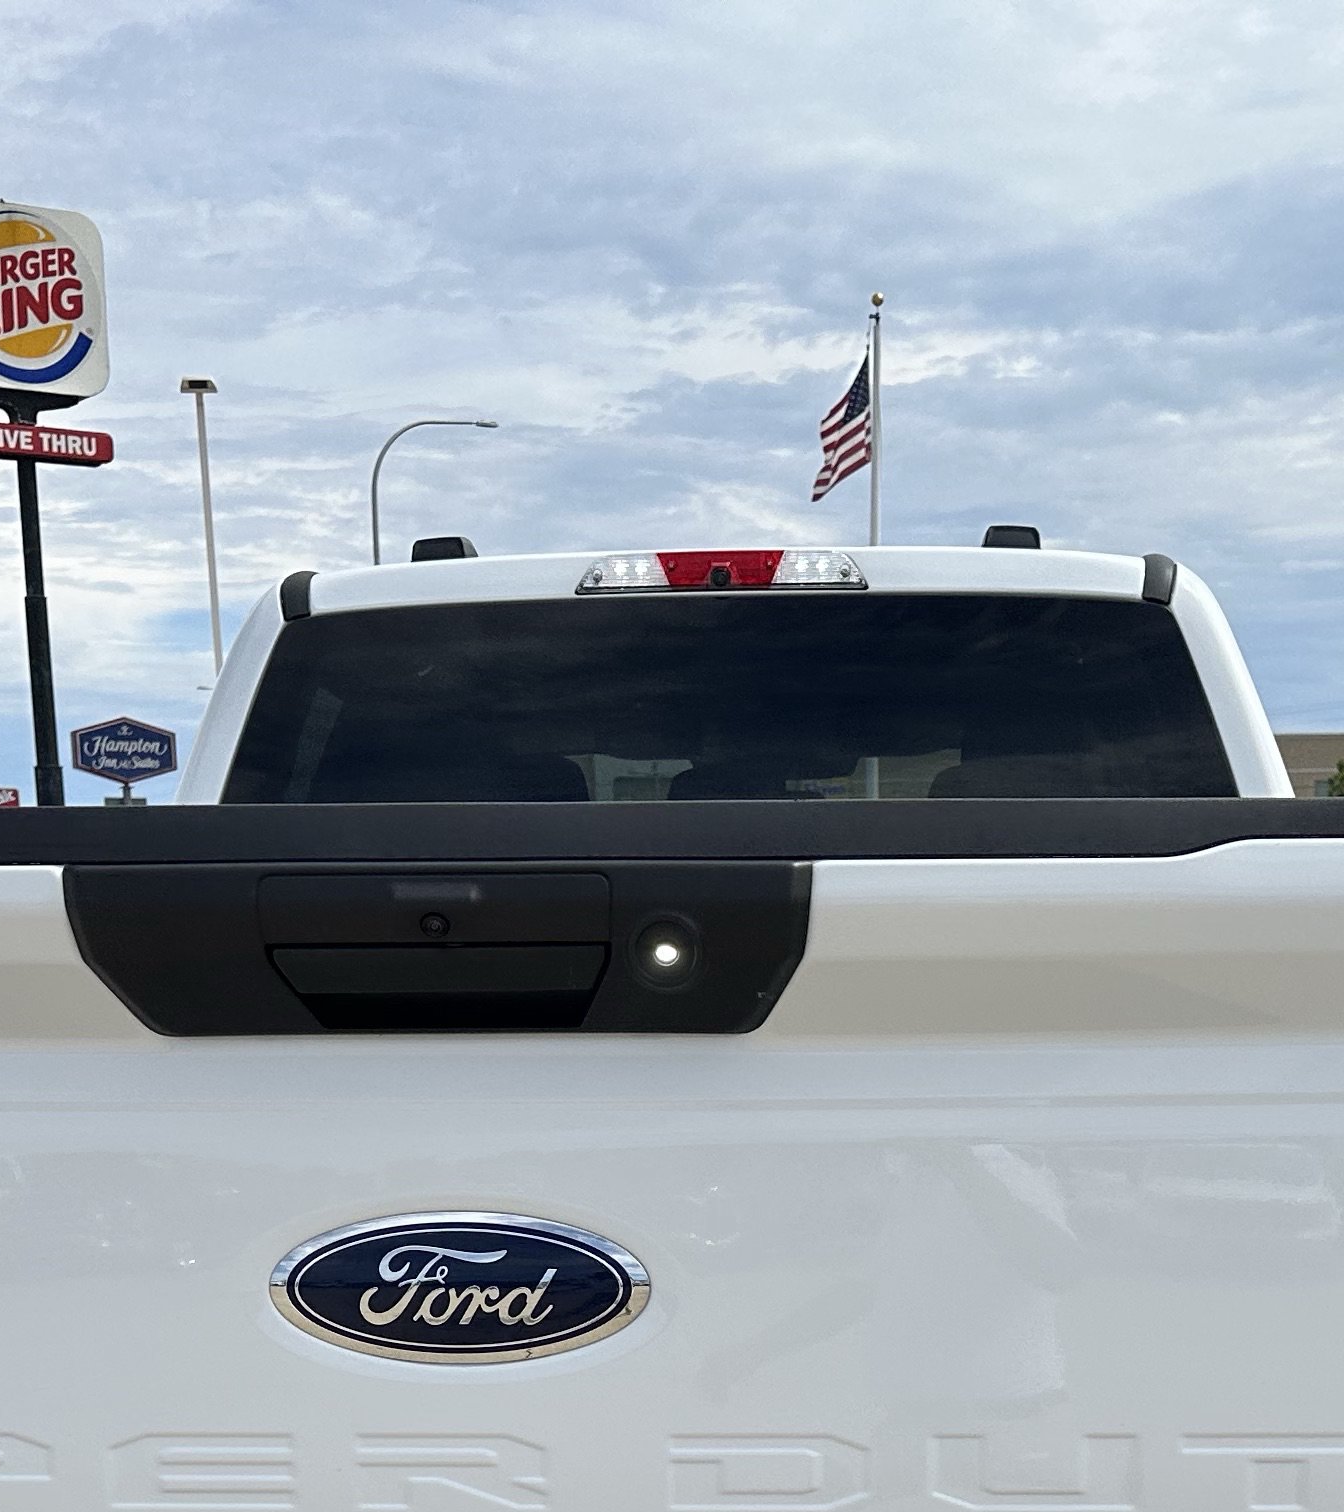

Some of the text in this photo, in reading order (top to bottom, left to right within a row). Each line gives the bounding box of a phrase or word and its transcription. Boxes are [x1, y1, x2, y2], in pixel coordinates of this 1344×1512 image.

[39, 432, 97, 457] THRU
[83, 735, 168, 757] Hampton
[359, 1244, 557, 1326] Ford
